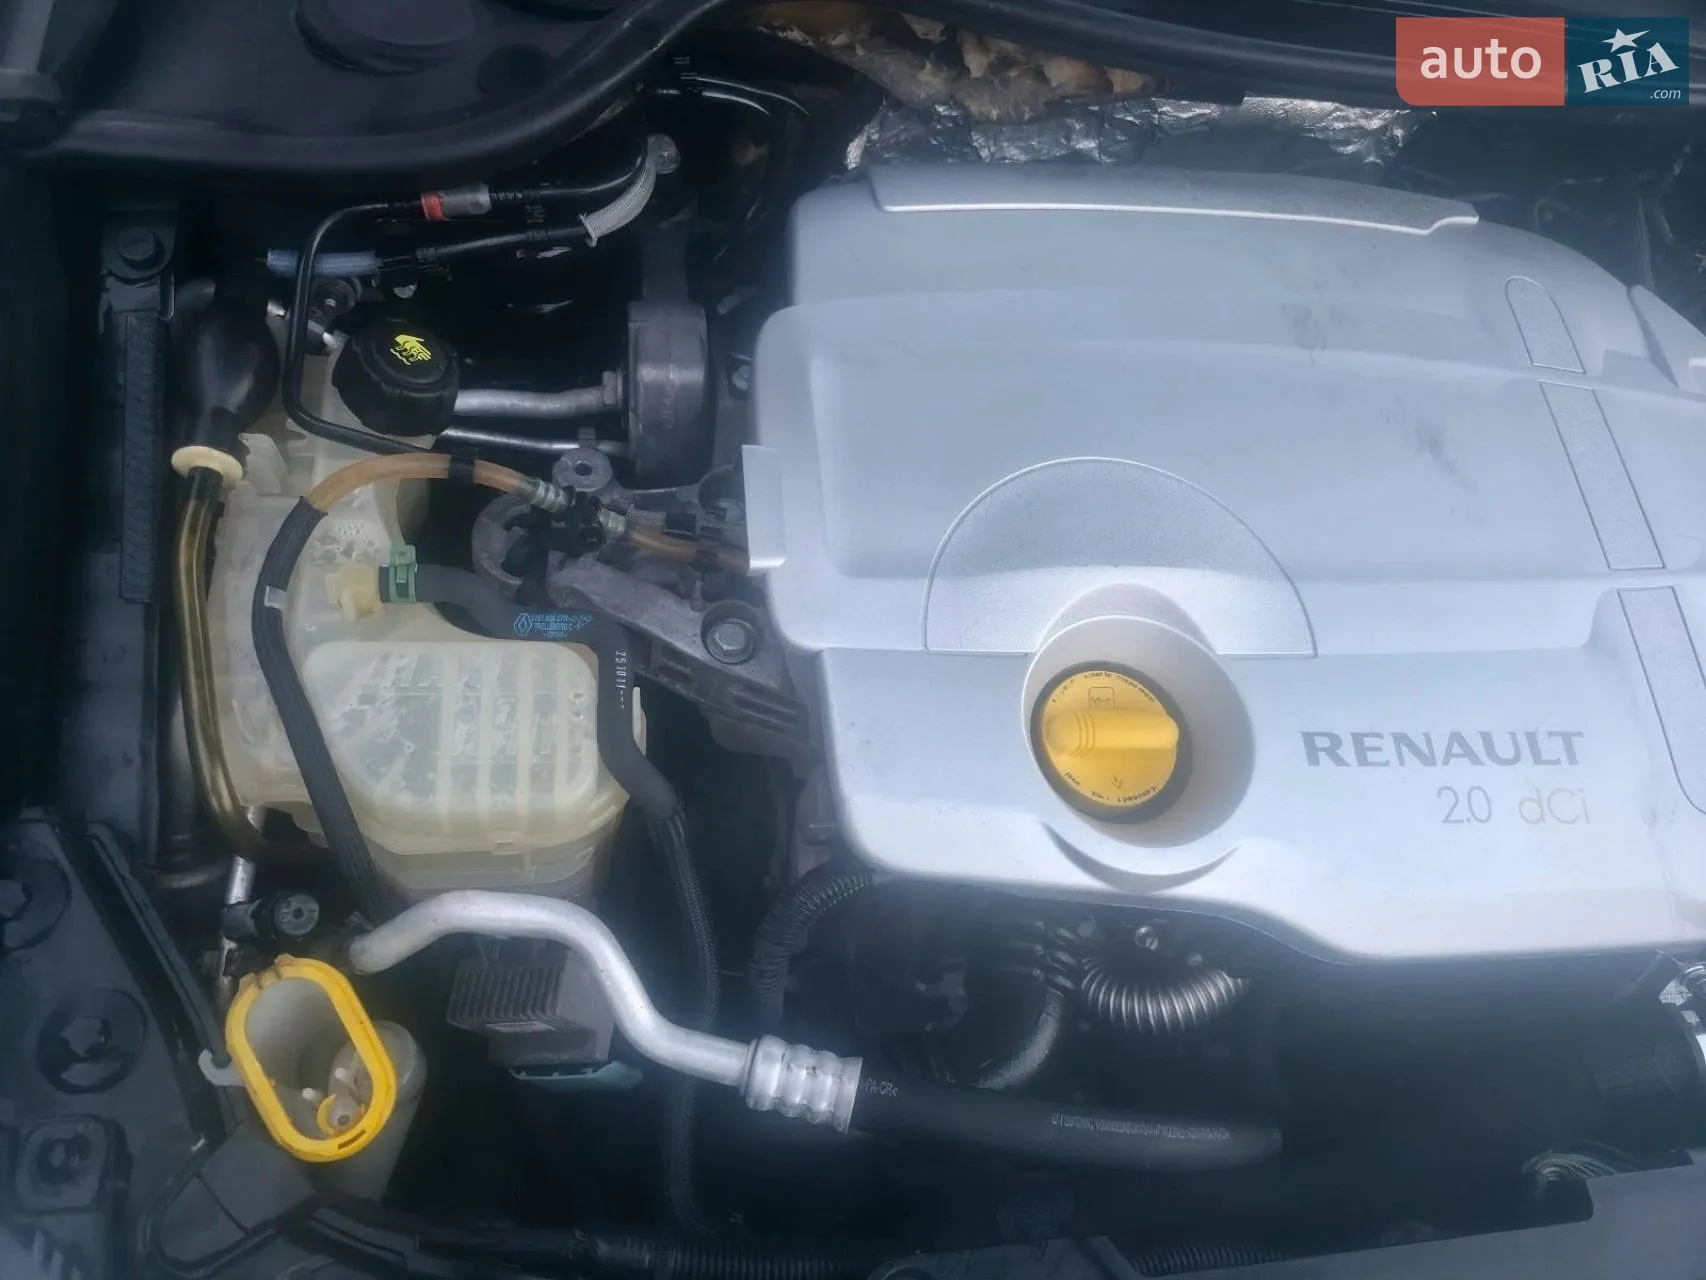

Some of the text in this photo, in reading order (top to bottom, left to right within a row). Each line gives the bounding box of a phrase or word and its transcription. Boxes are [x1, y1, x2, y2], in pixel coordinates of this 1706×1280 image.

[1300, 731, 1584, 768] RENAULT
[1436, 785, 1590, 825] 2.0 dCi
